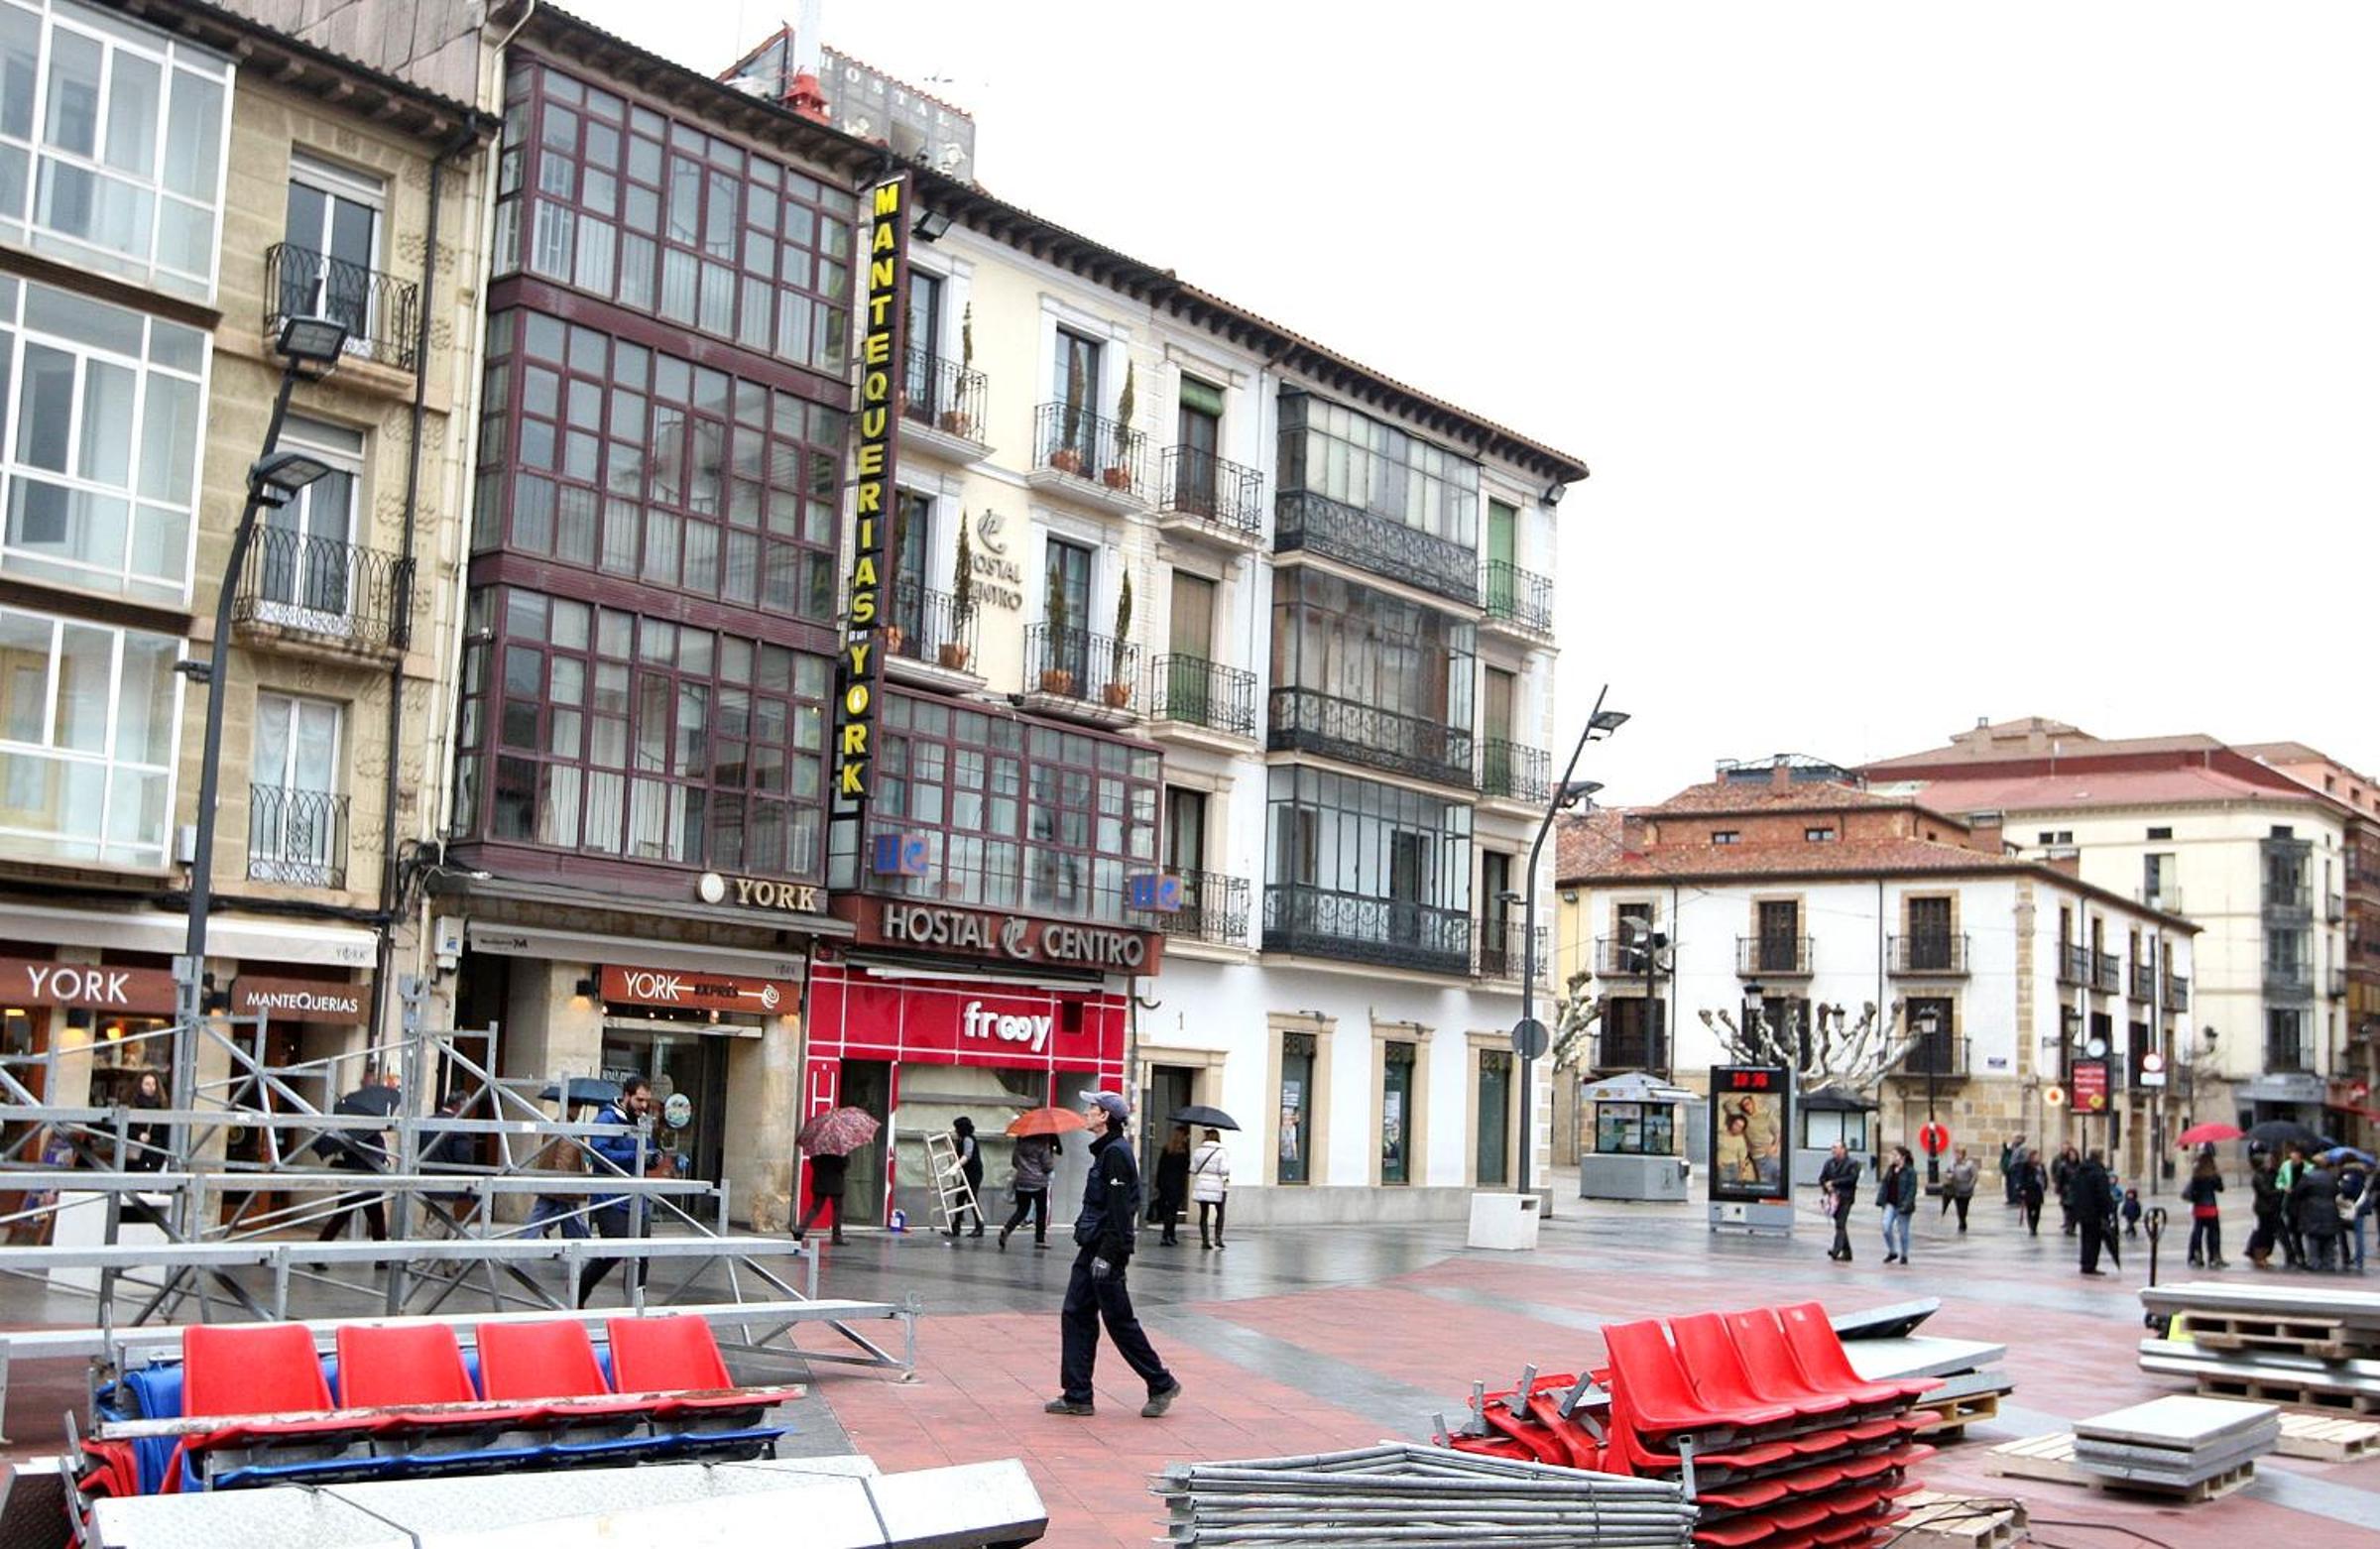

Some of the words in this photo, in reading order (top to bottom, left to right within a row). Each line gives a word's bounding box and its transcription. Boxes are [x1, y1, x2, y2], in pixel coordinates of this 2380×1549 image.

[820, 53, 950, 127] HOSTAL
[851, 183, 898, 623] MANTEQUERIAS
[973, 554, 1022, 584] OSTAL
[972, 579, 1022, 611] ENTRO
[843, 644, 870, 793] YORK
[736, 879, 817, 911] YORK
[883, 903, 995, 949] HOSTAL
[1042, 923, 1144, 967] CENTRO
[26, 966, 130, 1004] YORK
[246, 992, 358, 1013] MANTEQUERIAS
[624, 971, 680, 1002] YORK
[963, 1001, 1051, 1052] frooy
